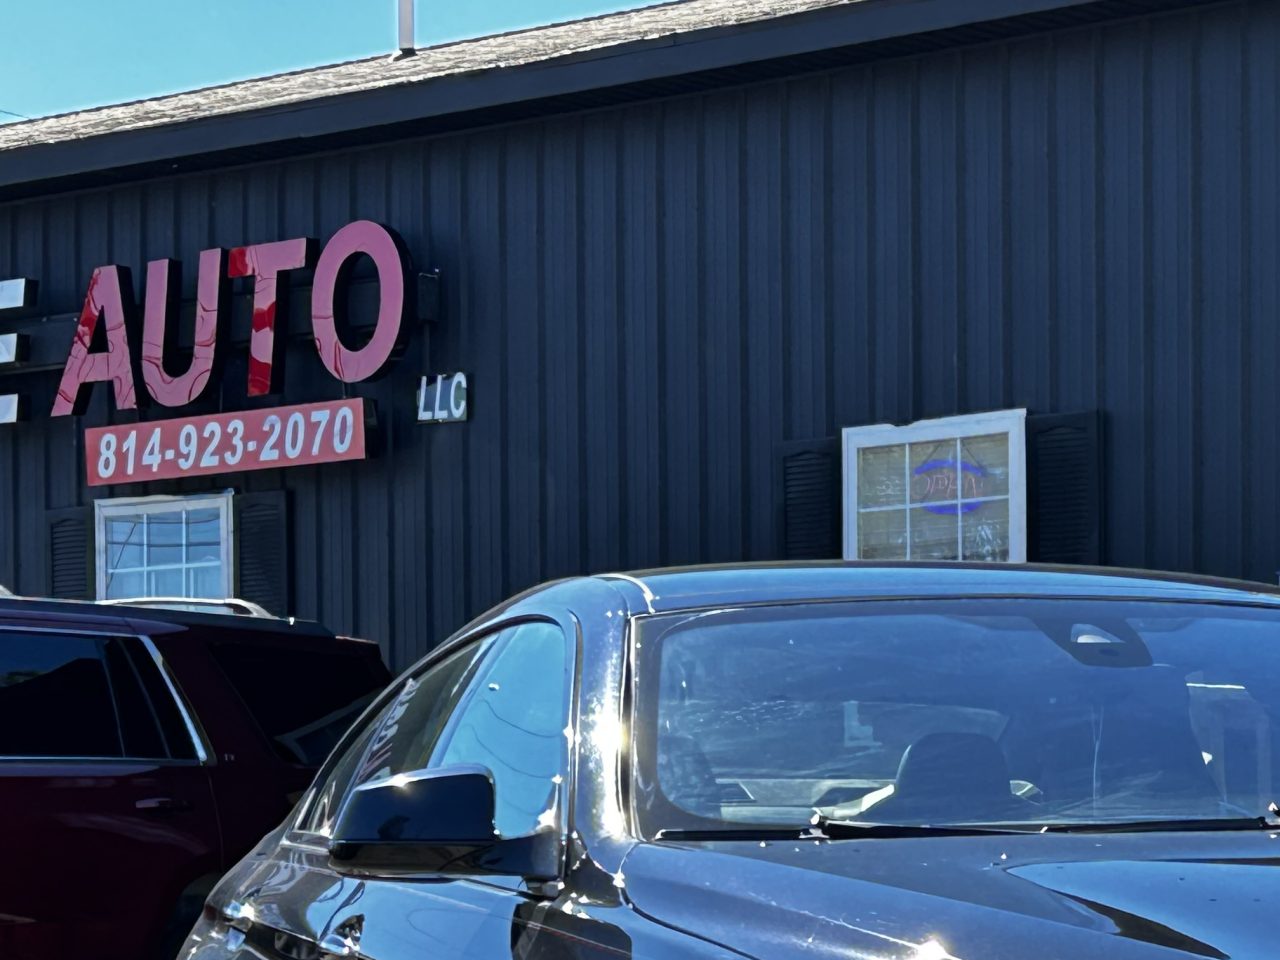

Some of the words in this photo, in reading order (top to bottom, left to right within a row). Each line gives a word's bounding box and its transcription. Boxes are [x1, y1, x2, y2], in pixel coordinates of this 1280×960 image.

[50, 220, 403, 416] AUTO
[418, 372, 467, 420] LLC
[98, 406, 354, 478] 814-923-2070
